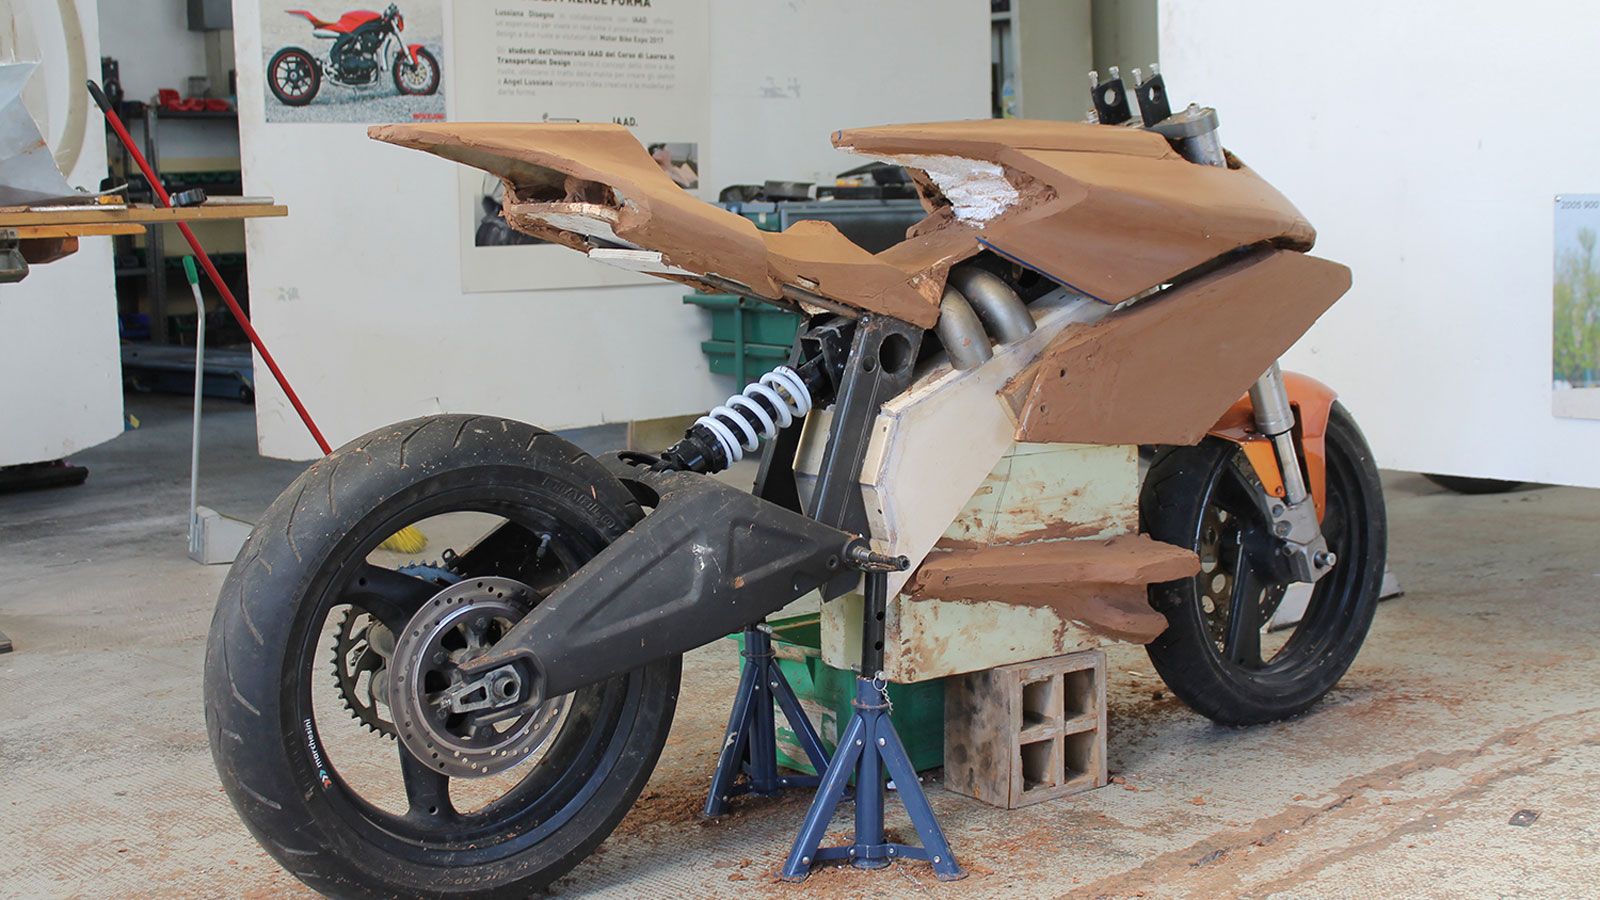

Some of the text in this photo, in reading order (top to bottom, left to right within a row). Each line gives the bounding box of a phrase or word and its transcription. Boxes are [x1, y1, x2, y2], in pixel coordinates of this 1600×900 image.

[529, 10, 554, 19] Disegno
[497, 56, 547, 65] Transportation
[549, 58, 571, 67] Design
[503, 78, 522, 86] Angel
[524, 78, 553, 86] Lussiana
[304, 718, 322, 768] marchesini
